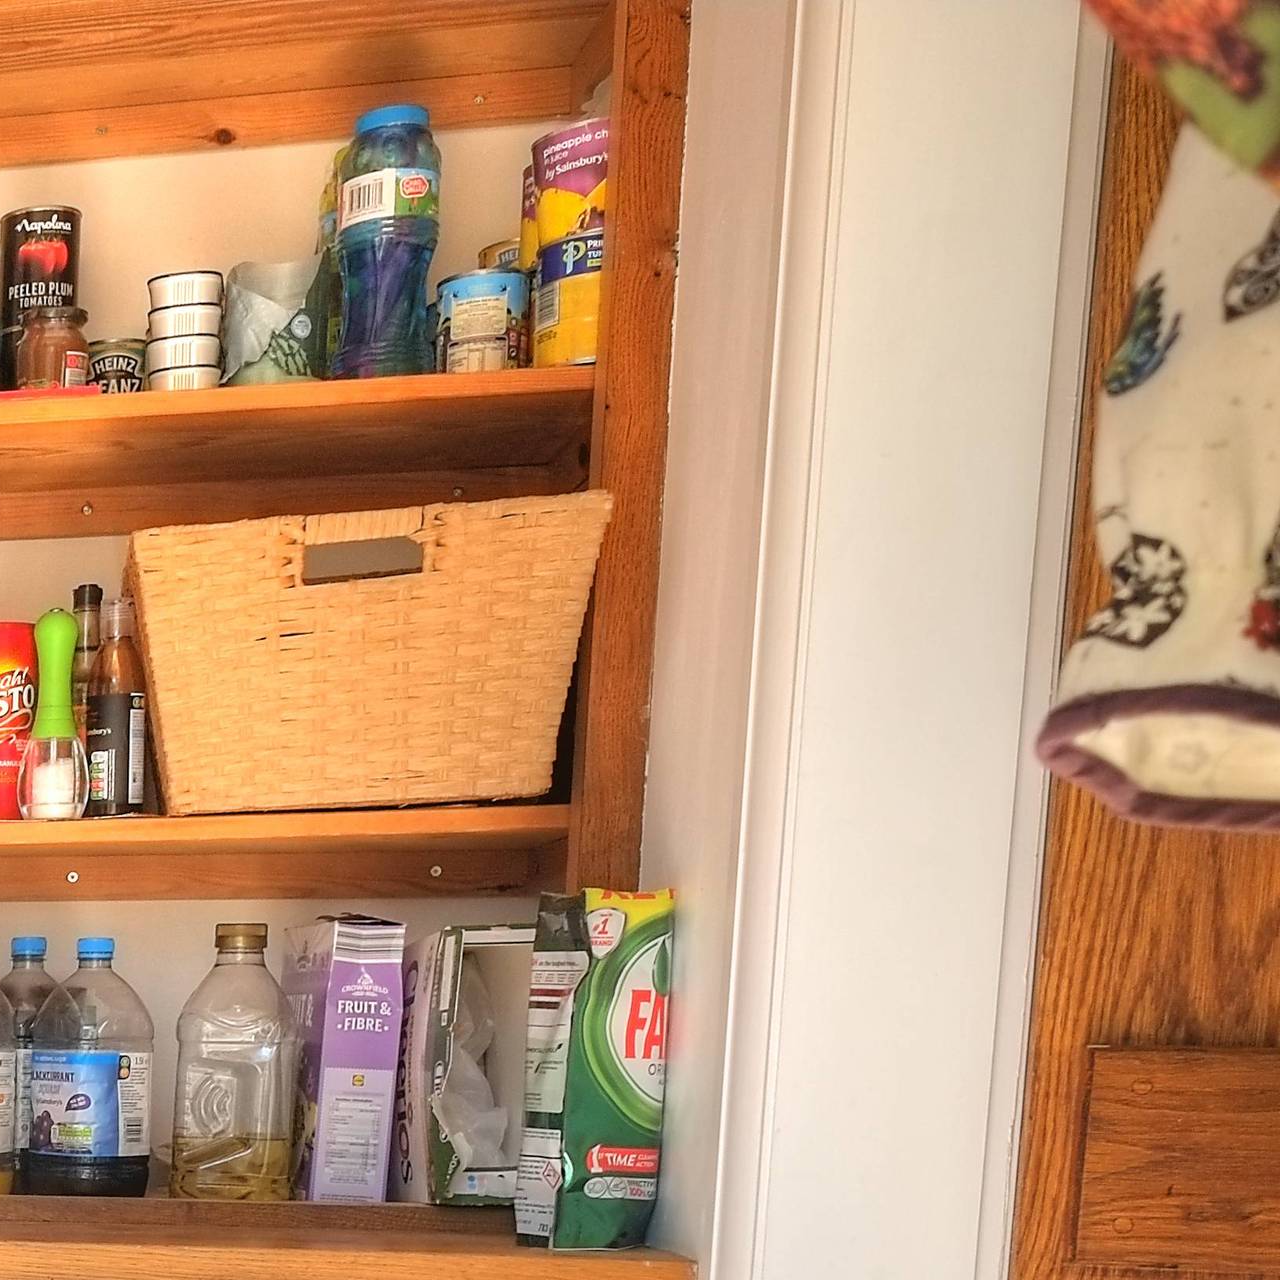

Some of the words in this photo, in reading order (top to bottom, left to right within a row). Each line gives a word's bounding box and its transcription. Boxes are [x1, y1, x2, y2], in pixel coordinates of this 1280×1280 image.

[543, 130, 592, 158] pineapple
[15, 213, 72, 234] Napolina
[8, 282, 46, 301] PEELED
[48, 280, 74, 297] PLUM
[19, 295, 63, 309] TOMATOES
[93, 355, 138, 373] HEINZ
[89, 377, 141, 394] EANZ
[341, 984, 389, 995] CROWNFIELD
[338, 1000, 377, 1015] FRUIT
[380, 1000, 393, 1016] &
[32, 1071, 75, 1083] LACKCURRANT
[606, 1153, 637, 1168] TIME
